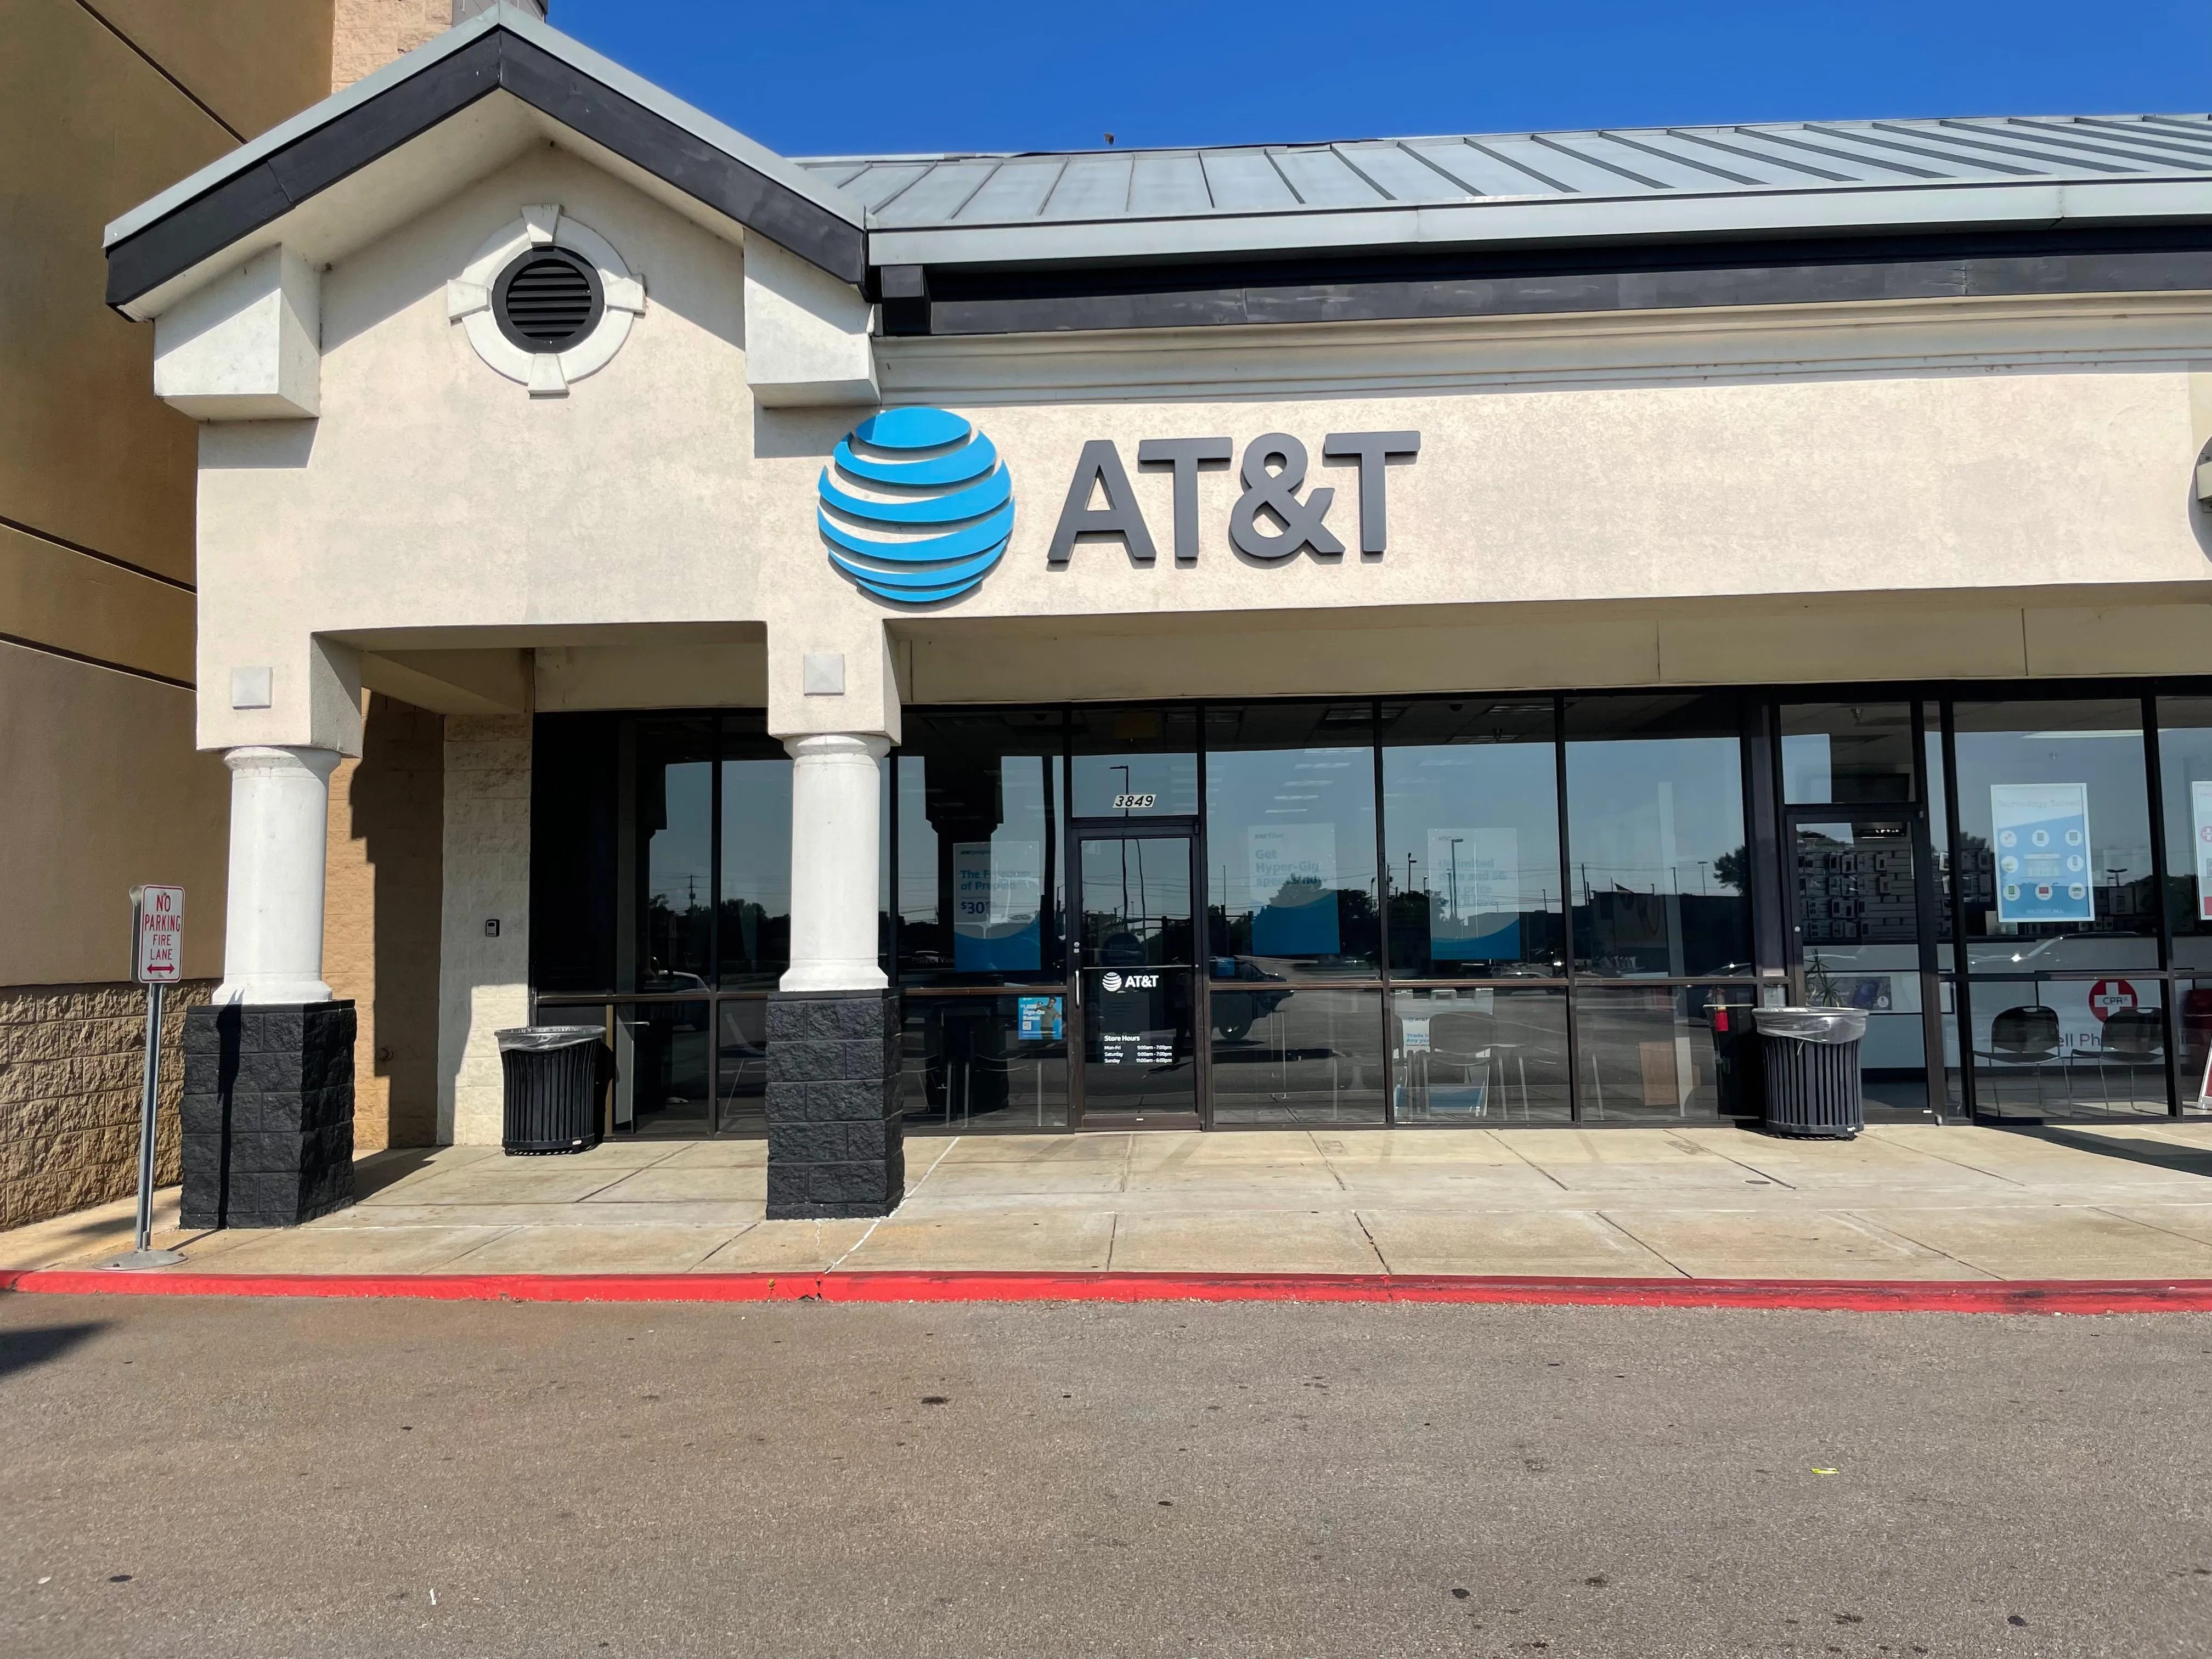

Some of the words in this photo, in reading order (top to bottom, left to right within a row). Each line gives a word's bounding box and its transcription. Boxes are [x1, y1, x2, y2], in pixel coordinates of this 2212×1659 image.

[1047, 431, 1421, 563] AT&T
[1115, 795, 1153, 806] 3849
[1997, 800, 2047, 809] Technology
[1256, 849, 1278, 860] Get
[1256, 861, 1319, 875] Hyper-Gig
[1438, 858, 1494, 868] Unimited
[961, 870, 980, 879] The
[1439, 870, 1464, 881] da
[961, 881, 973, 890] of
[157, 895, 171, 912] NO
[961, 901, 985, 915] $30
[144, 914, 180, 932] PARKING
[153, 934, 171, 946] FIRE
[150, 949, 172, 960] LANE
[1125, 975, 1159, 988] AT&T
[2058, 1034, 2073, 1047] ell
